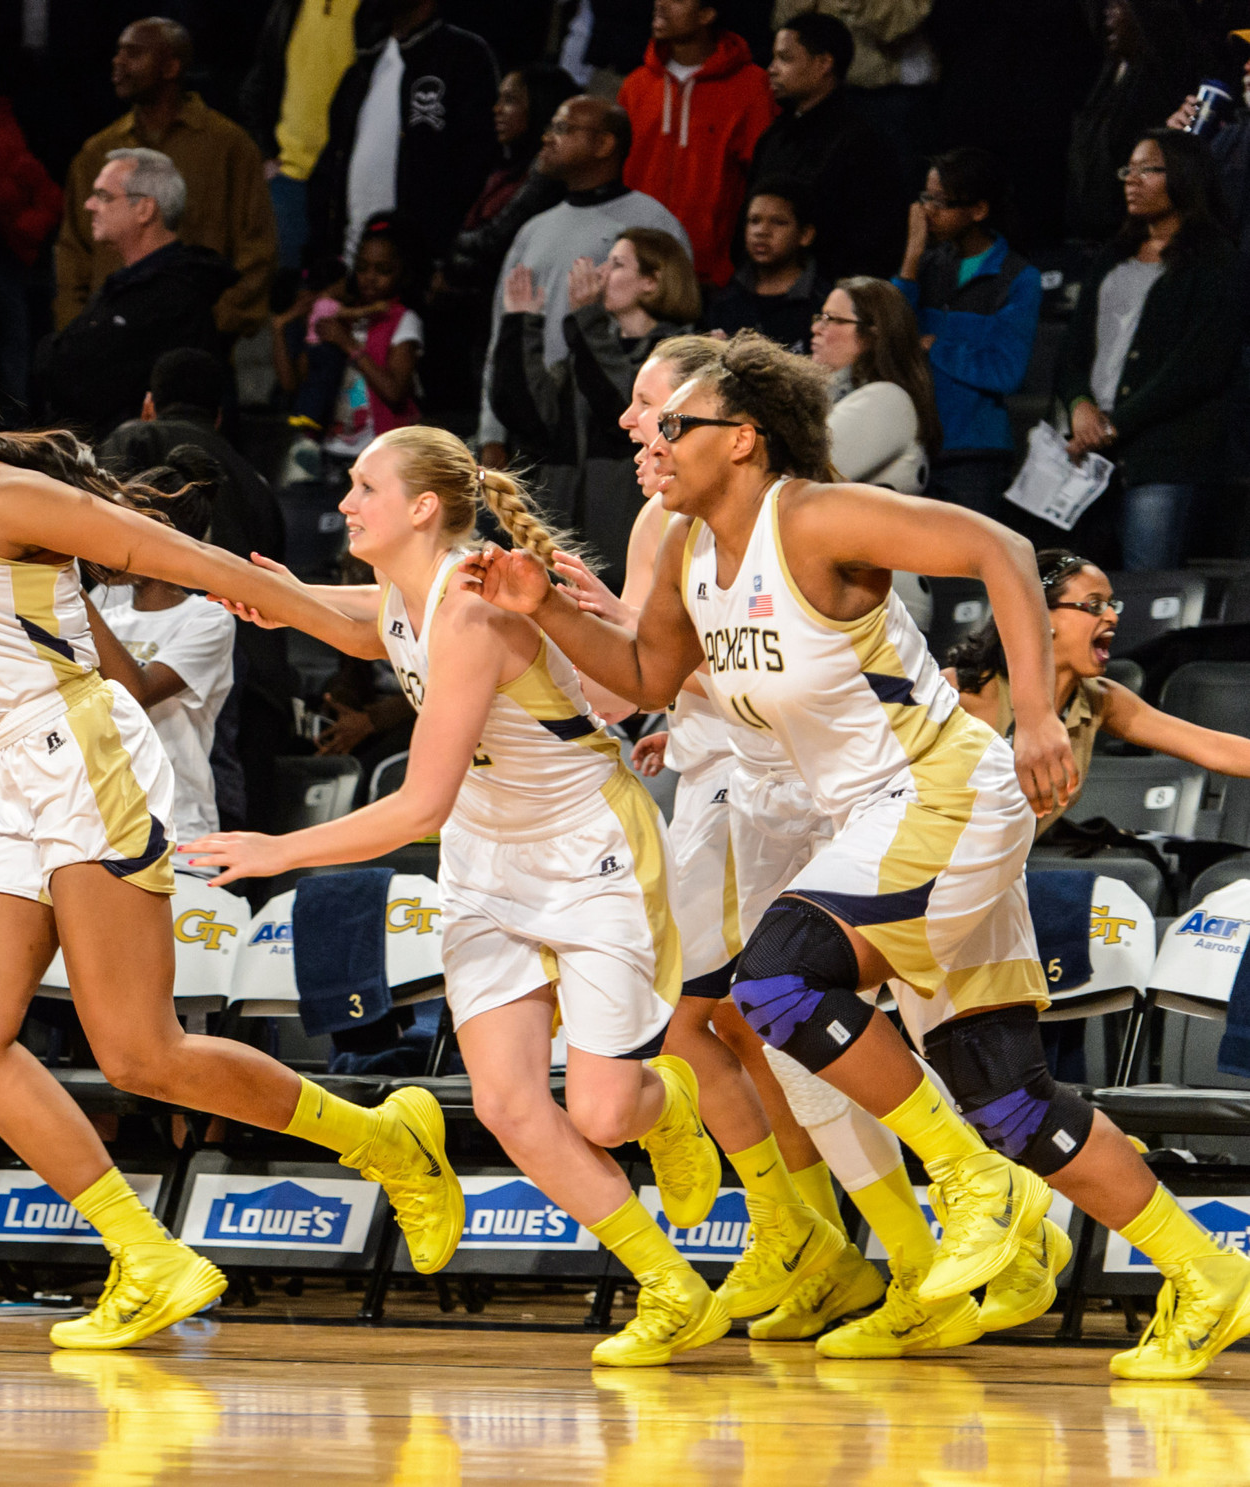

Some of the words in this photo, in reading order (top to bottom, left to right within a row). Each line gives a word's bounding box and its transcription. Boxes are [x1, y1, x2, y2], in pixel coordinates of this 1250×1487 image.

[705, 627, 784, 673] ACKETS
[174, 908, 238, 950] GT
[1048, 957, 1063, 983] 5
[349, 993, 364, 1019] 3
[219, 1202, 335, 1238] LOWE'S
